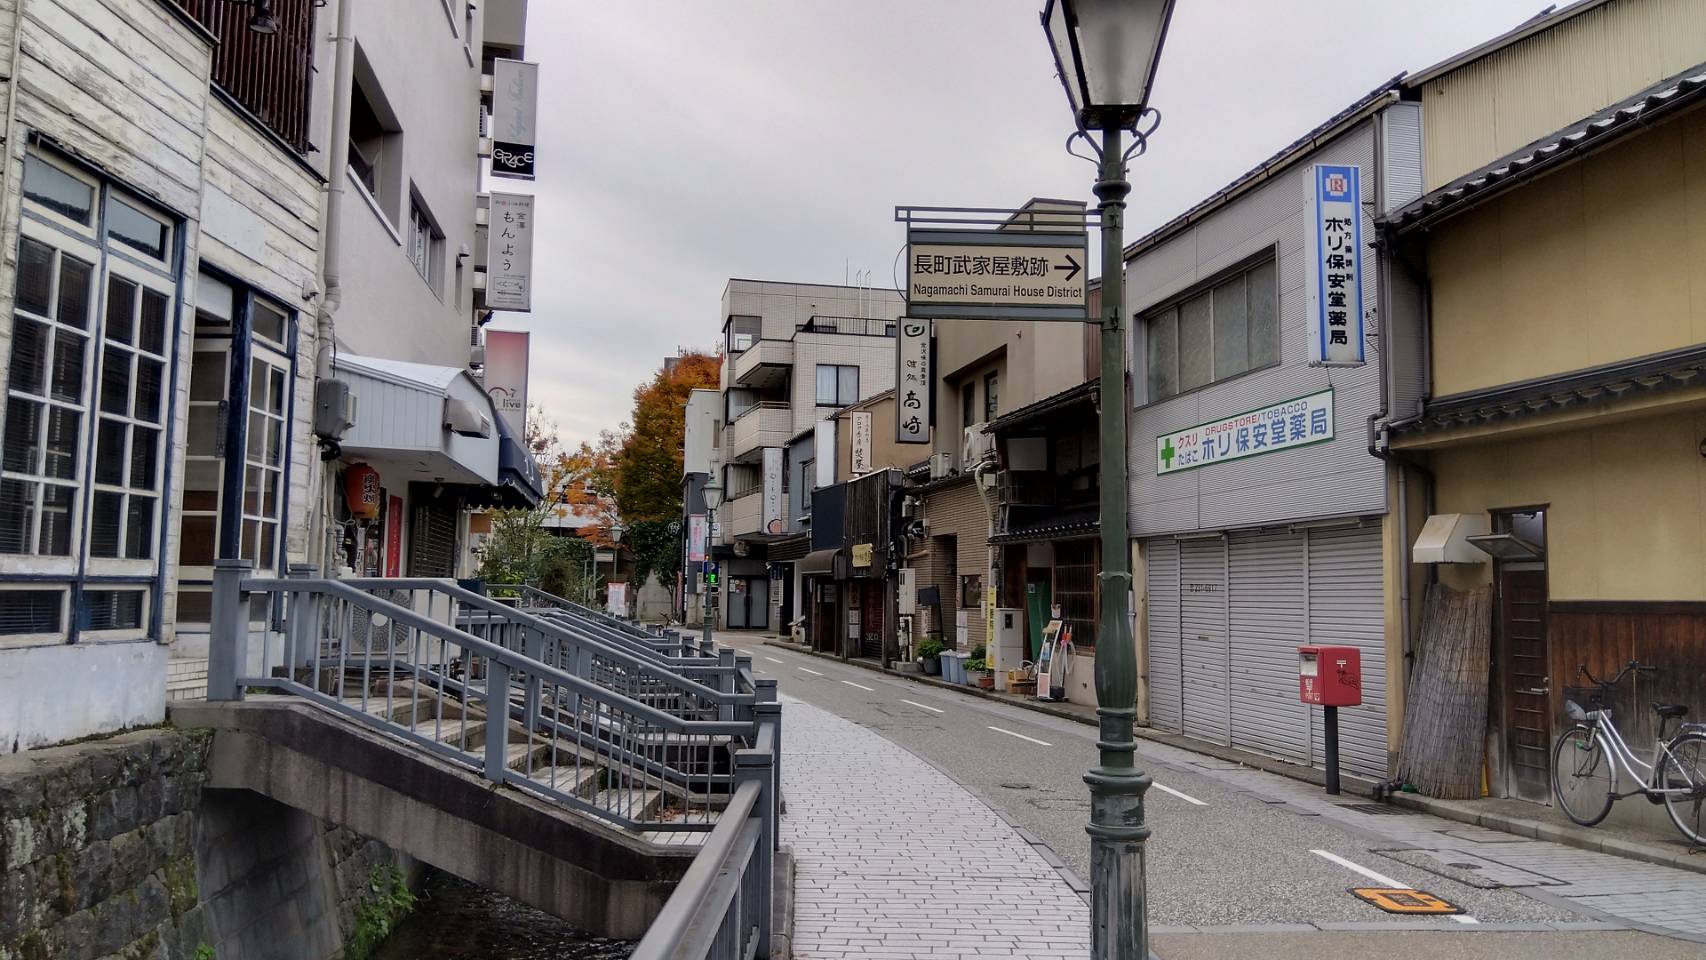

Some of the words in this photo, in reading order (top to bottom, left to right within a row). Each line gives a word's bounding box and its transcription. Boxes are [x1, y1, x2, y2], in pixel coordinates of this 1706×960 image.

[493, 148, 534, 168] GRACE
[501, 211, 515, 271] もんよう
[913, 254, 1049, 277] 長町武家屋敷跡
[913, 283, 968, 297] Nagamachi
[970, 284, 1010, 297] Samurai
[1013, 285, 1044, 297] House
[1047, 286, 1082, 298] District
[1325, 217, 1348, 345] ホリ保安堂薬局
[1205, 401, 1308, 436] DRUGSTORE/TOBACCO
[1178, 431, 1198, 449] クスリ
[1201, 407, 1327, 460] ホリ保安堂薬局
[1178, 449, 1198, 466] たばこ
